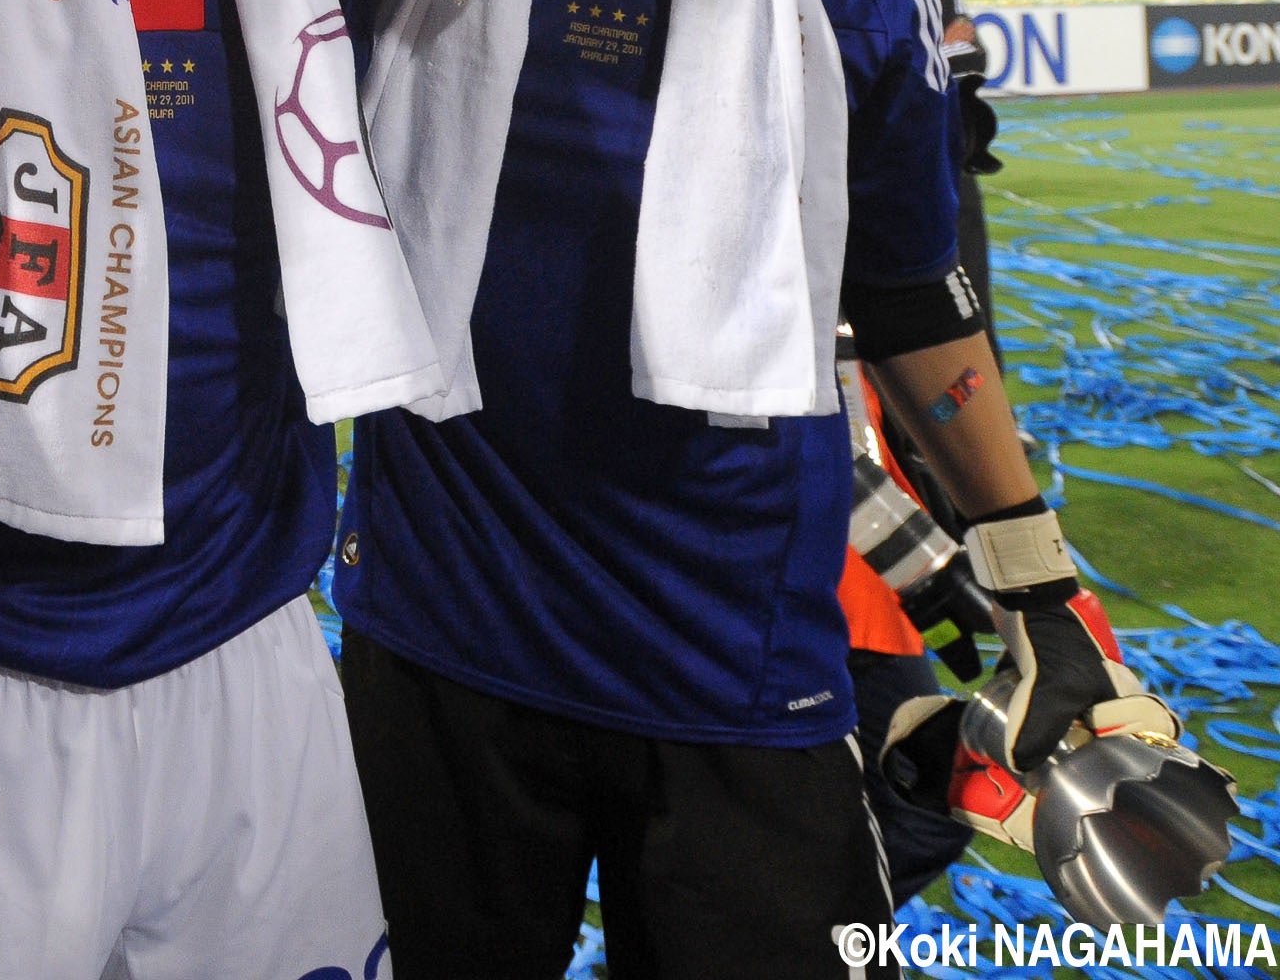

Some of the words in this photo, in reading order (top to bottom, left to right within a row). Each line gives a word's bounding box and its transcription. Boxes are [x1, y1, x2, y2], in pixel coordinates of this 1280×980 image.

[562, 33, 604, 48] JANUARY
[622, 43, 643, 56] 2011
[591, 25, 639, 42] CHAMPION
[175, 95, 195, 105] 2011
[111, 97, 141, 210] ASIAN
[90, 222, 136, 448] CHAMPIONS
